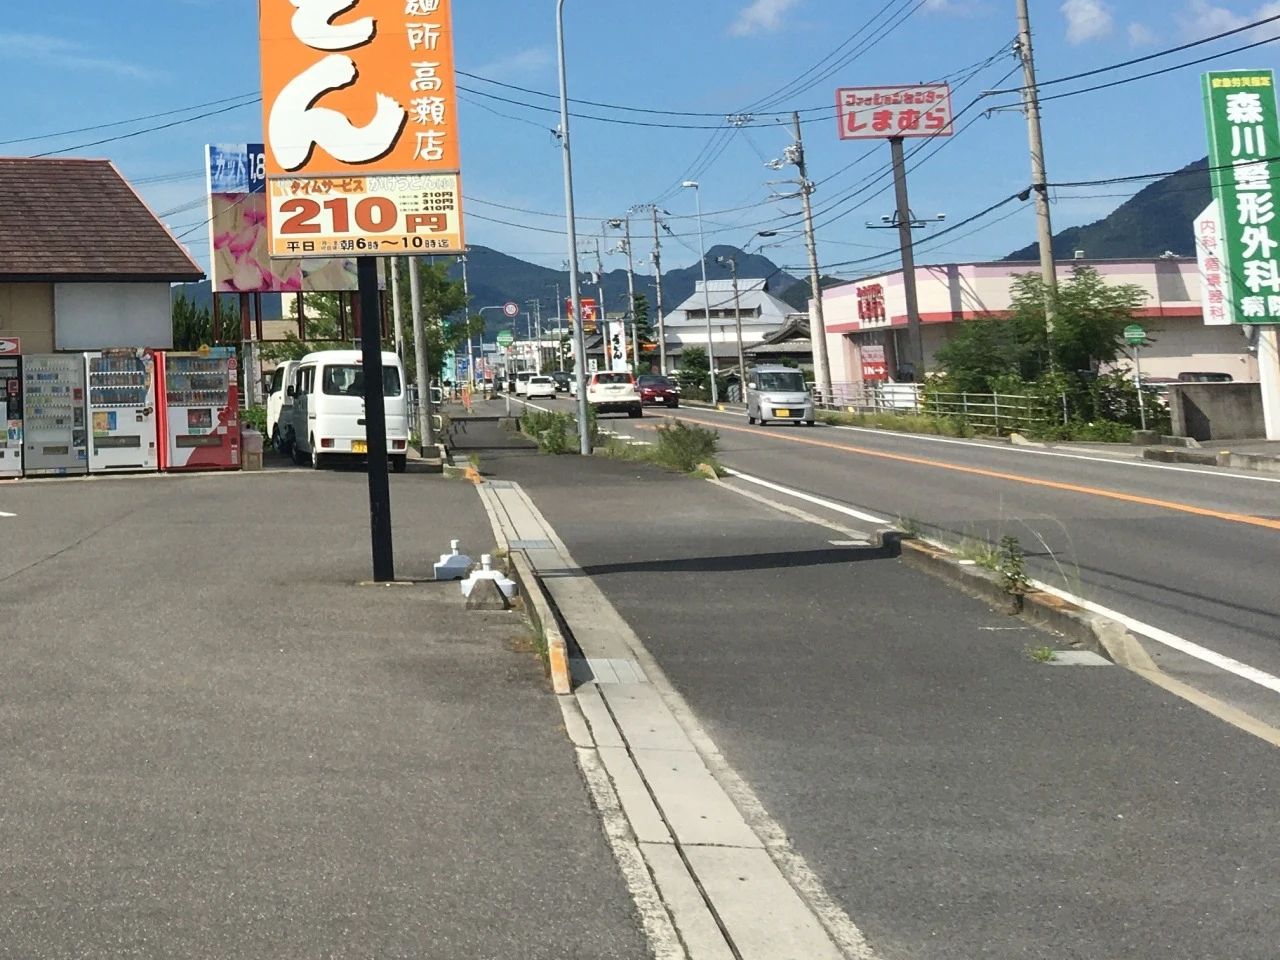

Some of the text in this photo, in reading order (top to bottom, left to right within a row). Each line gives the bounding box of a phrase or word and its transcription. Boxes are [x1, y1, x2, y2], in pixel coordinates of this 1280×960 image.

[847, 108, 946, 132] しまむら
[290, 178, 365, 196] タイムサービス
[422, 191, 454, 199] 210円
[423, 204, 455, 212] 410円
[287, 241, 315, 252] 平日
[864, 366, 875, 375] IN
